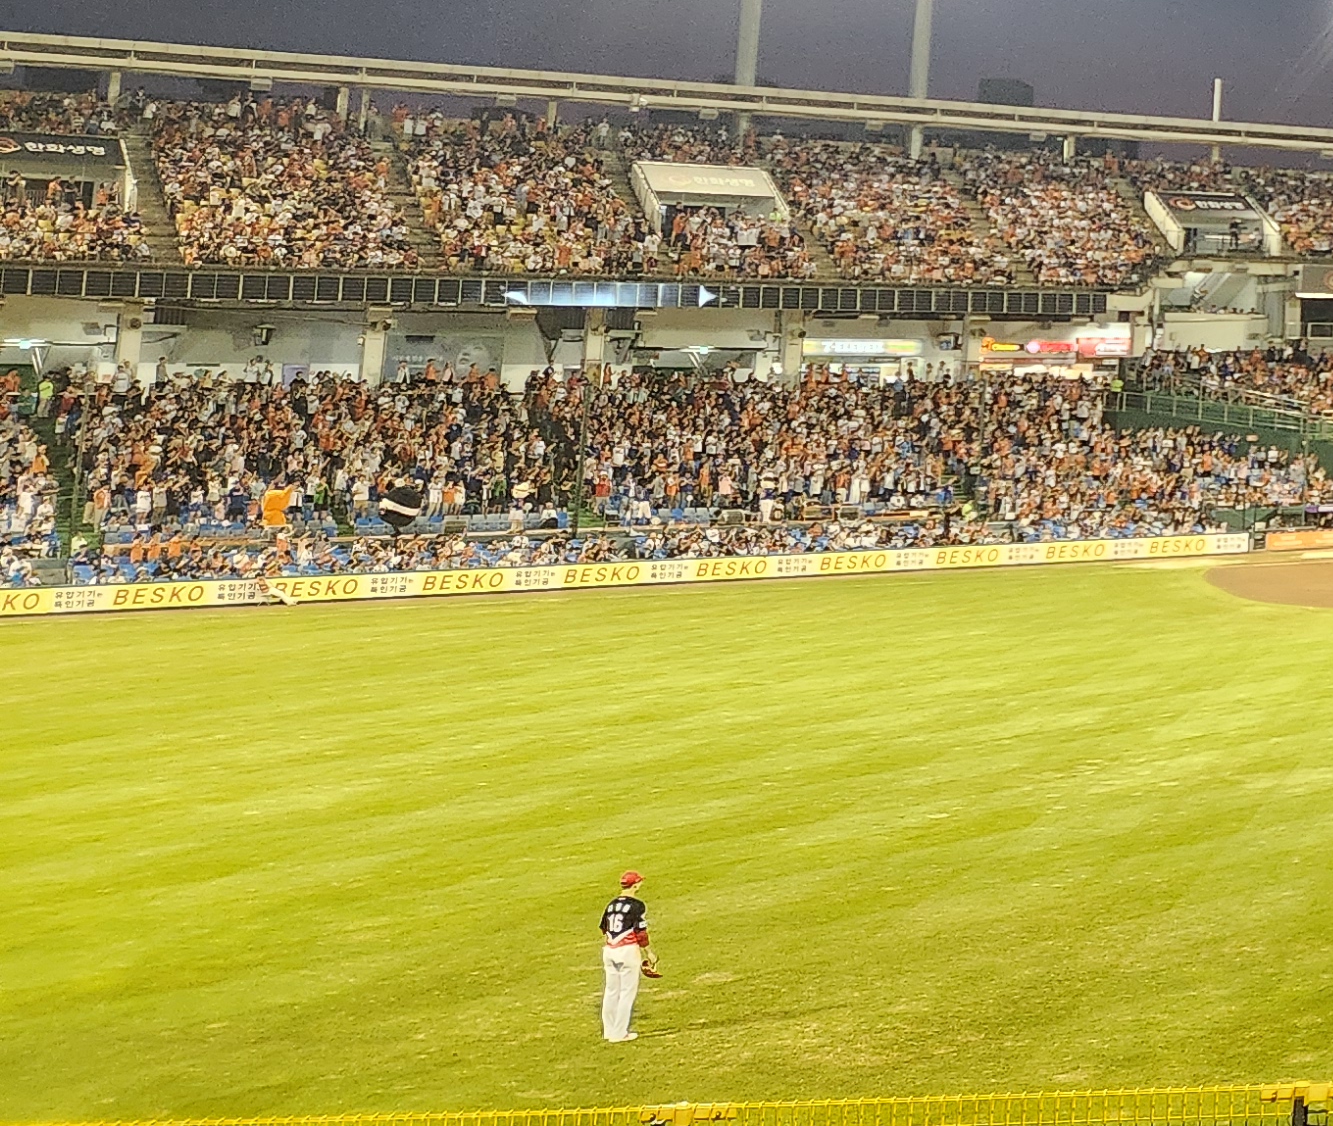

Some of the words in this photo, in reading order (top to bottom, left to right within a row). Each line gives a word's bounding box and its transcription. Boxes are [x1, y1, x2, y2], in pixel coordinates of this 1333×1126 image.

[24, 141, 106, 156] 한화생명
[1046, 543, 1105, 559] BESKO
[1150, 539, 1206, 554] BESKO
[820, 554, 886, 571] BESKO
[936, 548, 999, 565] BESKO
[564, 566, 640, 584] BESKO
[696, 560, 767, 577] BESKO
[422, 572, 504, 591] BESKO
[113, 585, 205, 606] BESKO
[607, 913, 624, 933] 16
